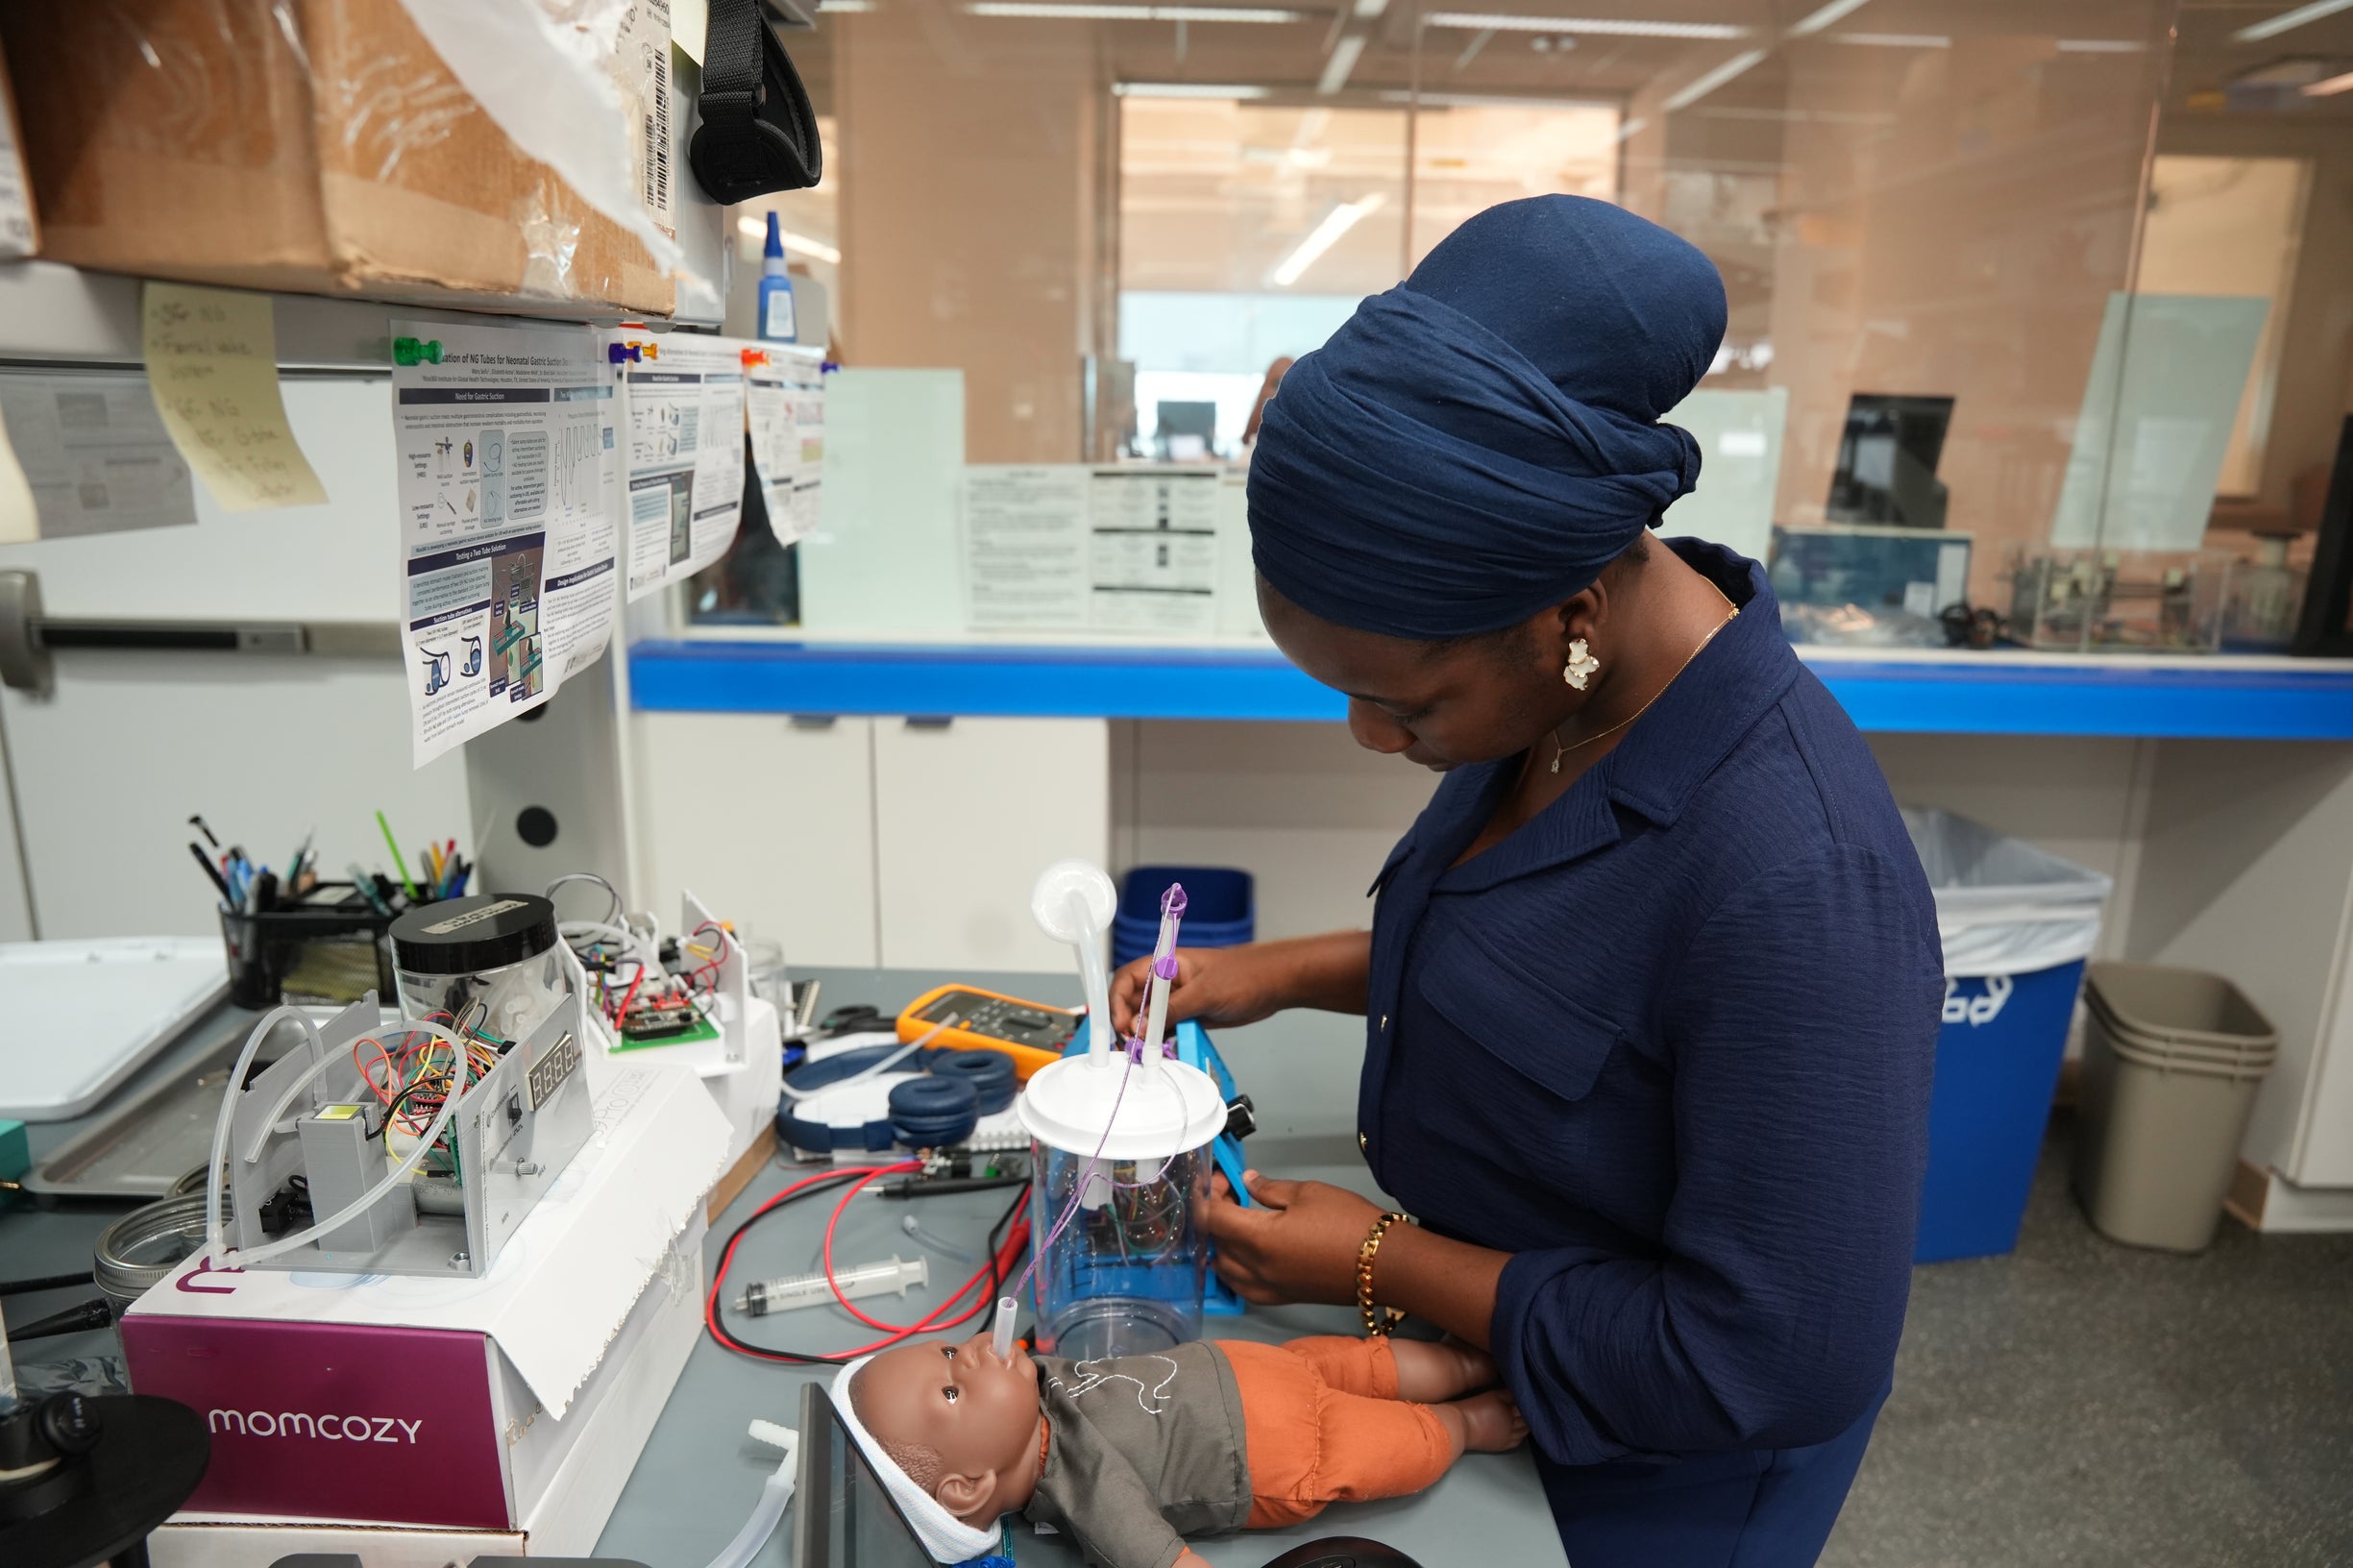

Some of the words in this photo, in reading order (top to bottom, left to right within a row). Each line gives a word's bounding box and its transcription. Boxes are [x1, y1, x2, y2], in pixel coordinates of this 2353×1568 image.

[462, 354, 470, 365] of
[471, 355, 479, 365] NG
[480, 355, 497, 367] Tubes
[505, 355, 529, 366] Neonatal
[530, 355, 546, 366] Gastric
[455, 392, 467, 401] Need
[475, 392, 488, 401] Gastric
[489, 392, 504, 401] Suction
[491, 544, 506, 554] Solution
[433, 615, 447, 624] Suction
